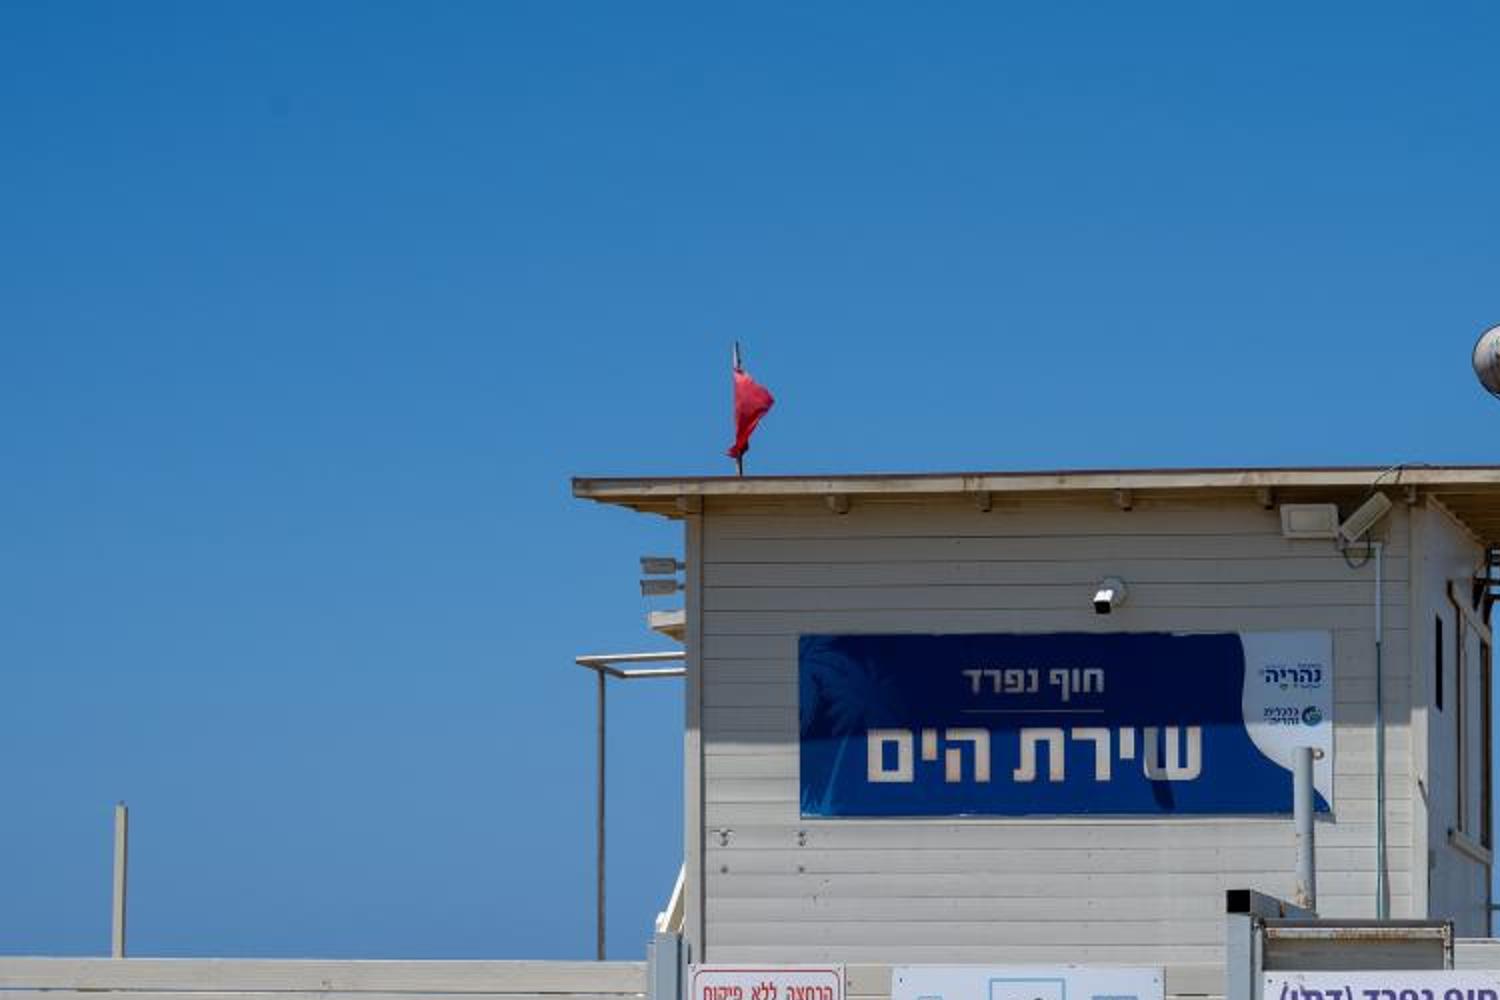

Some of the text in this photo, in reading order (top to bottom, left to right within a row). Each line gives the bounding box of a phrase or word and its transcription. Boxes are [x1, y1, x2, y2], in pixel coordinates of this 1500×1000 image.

[962, 667, 1105, 702] חוף נפרד
[1264, 668, 1322, 684] נהריה
[867, 727, 1203, 783] שירת הים
